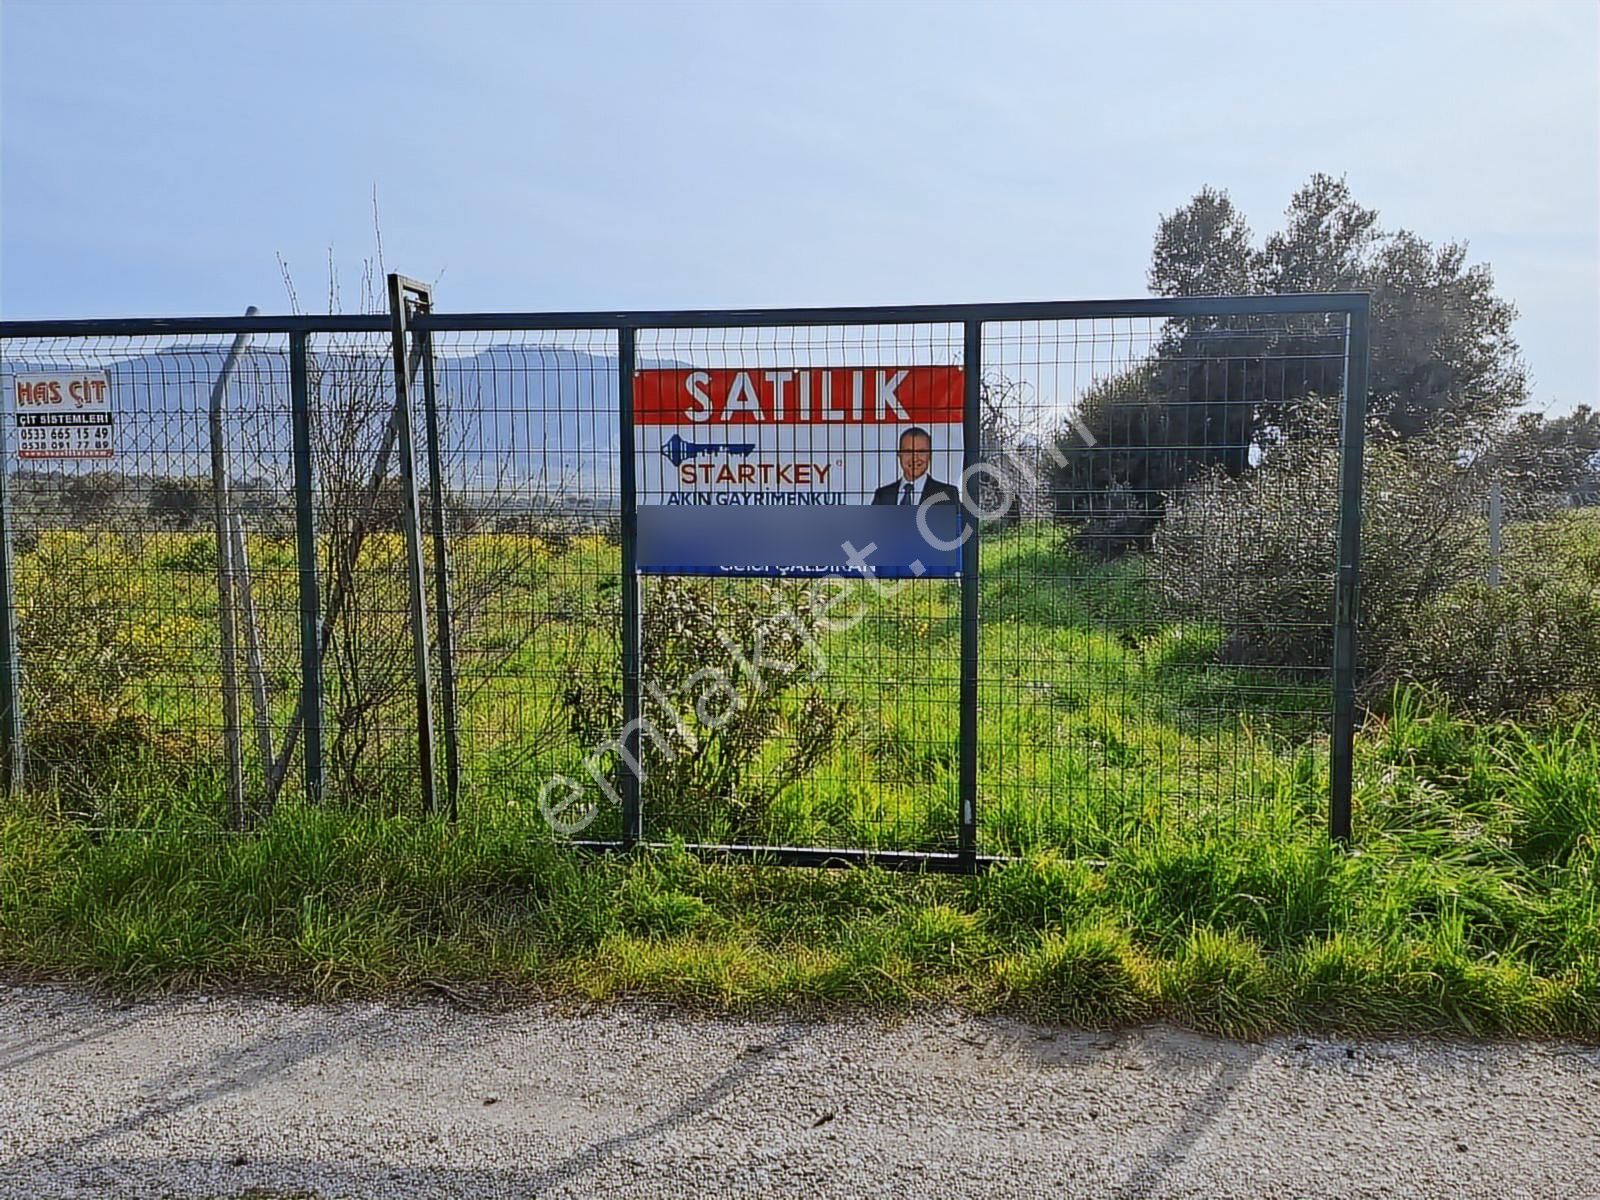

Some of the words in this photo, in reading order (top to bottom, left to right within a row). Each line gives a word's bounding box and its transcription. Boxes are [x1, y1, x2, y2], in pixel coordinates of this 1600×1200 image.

[684, 370, 910, 422] SATILIK
[21, 429, 46, 440] 0533
[51, 428, 71, 440] 665
[77, 428, 89, 439] 15
[95, 427, 109, 439] 49
[681, 463, 831, 485] STARTKEY
[668, 491, 712, 506] AKIN
